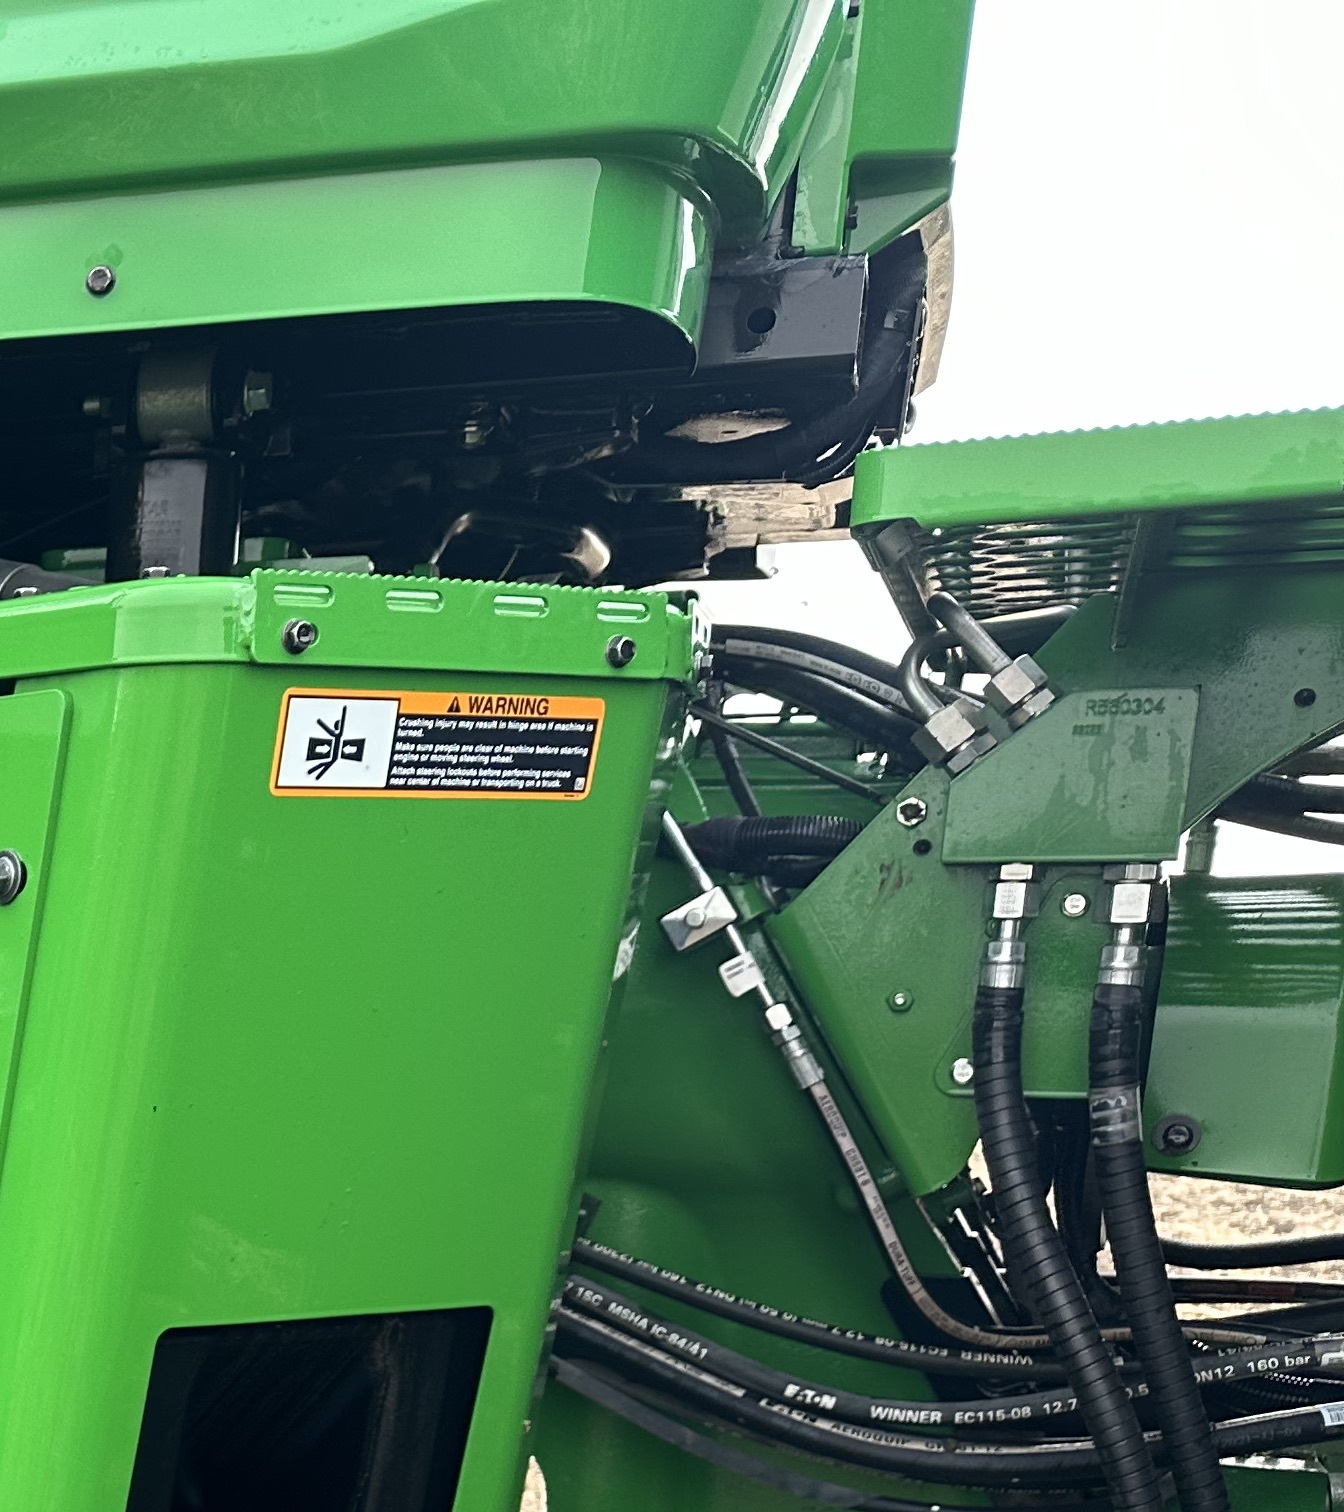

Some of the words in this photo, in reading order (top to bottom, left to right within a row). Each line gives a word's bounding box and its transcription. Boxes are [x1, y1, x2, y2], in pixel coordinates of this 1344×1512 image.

[469, 696, 549, 716] WARNING
[607, 1302, 649, 1330] MSHA
[870, 1405, 943, 1424] WINNER
[954, 1406, 1032, 1424] EC115-08
[1042, 1398, 1078, 1415] 12.7
[1247, 1357, 1279, 1373] 160
[1284, 1354, 1311, 1368] bar
